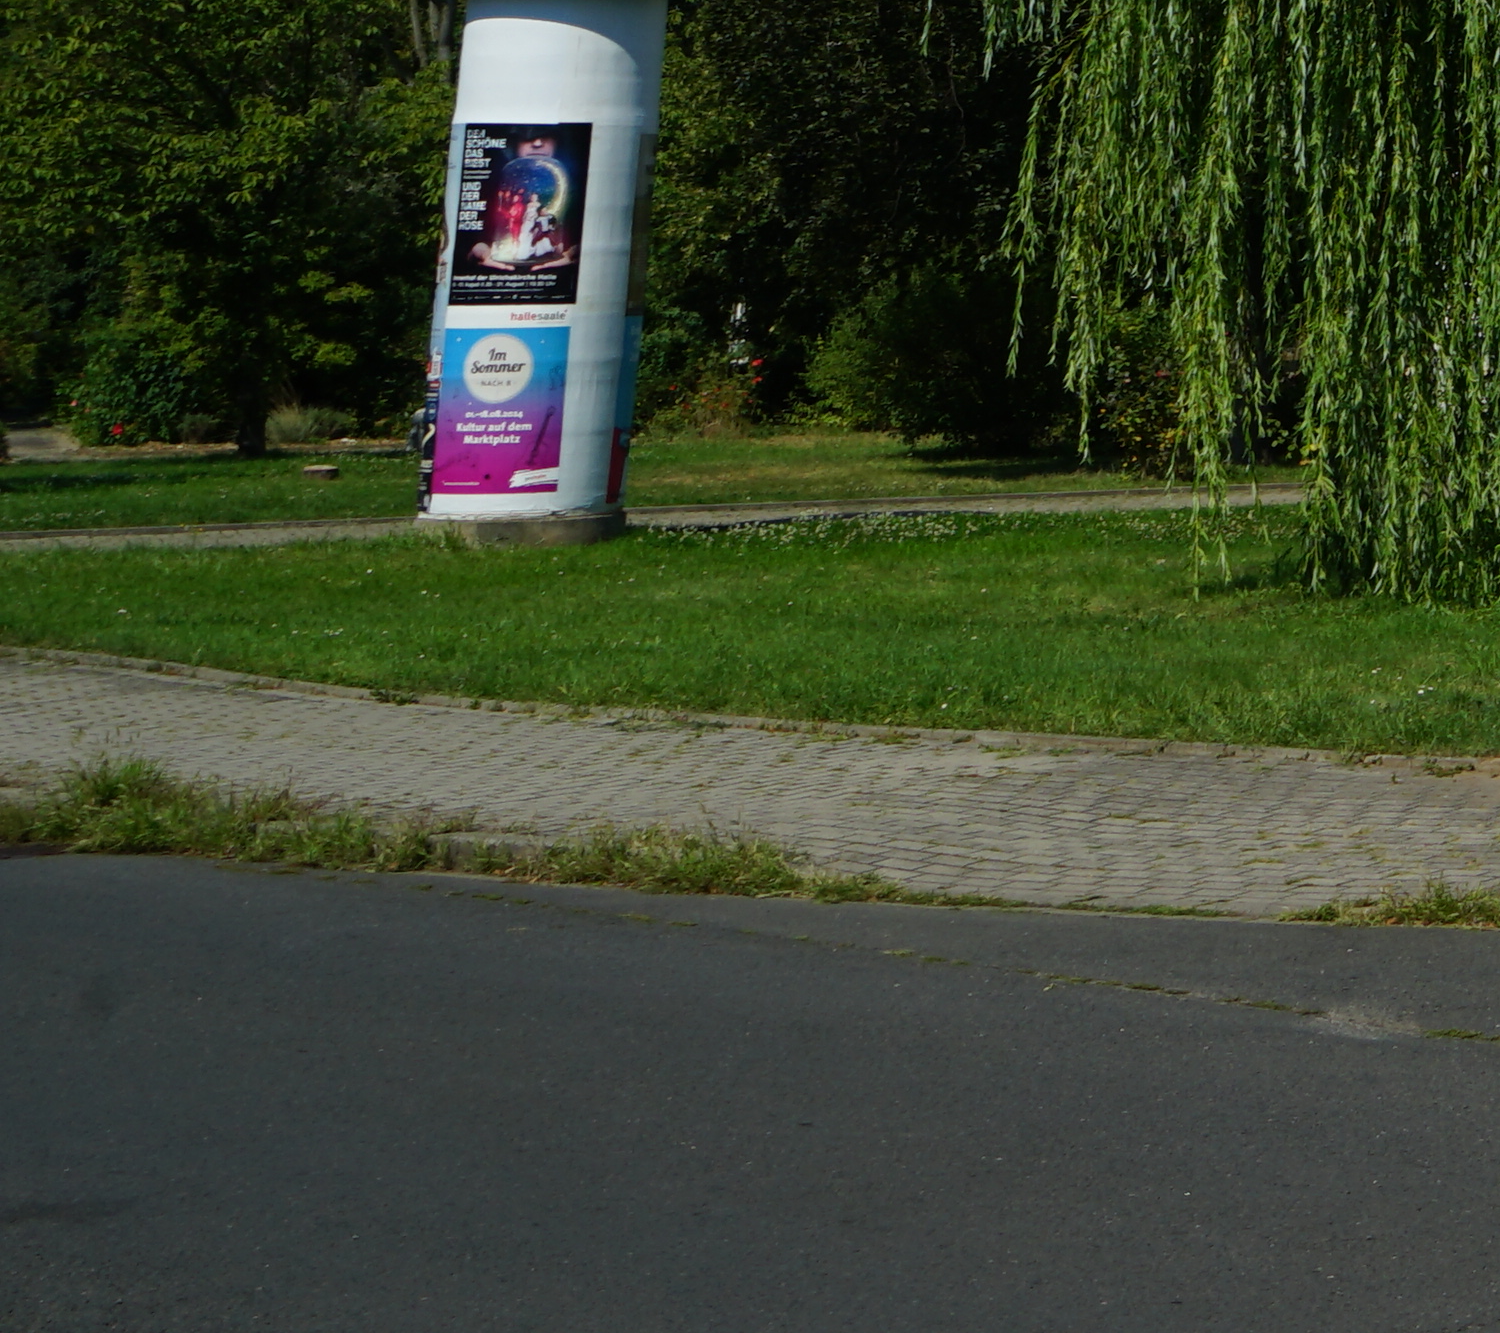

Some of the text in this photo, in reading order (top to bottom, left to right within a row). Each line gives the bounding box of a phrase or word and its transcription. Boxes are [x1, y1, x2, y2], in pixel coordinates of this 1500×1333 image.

[459, 211, 478, 221] DER
[488, 347, 507, 362] Im
[471, 360, 526, 374] Sommer
[456, 421, 532, 432] Kultur auf dem
[463, 433, 521, 446] Marktplatz
